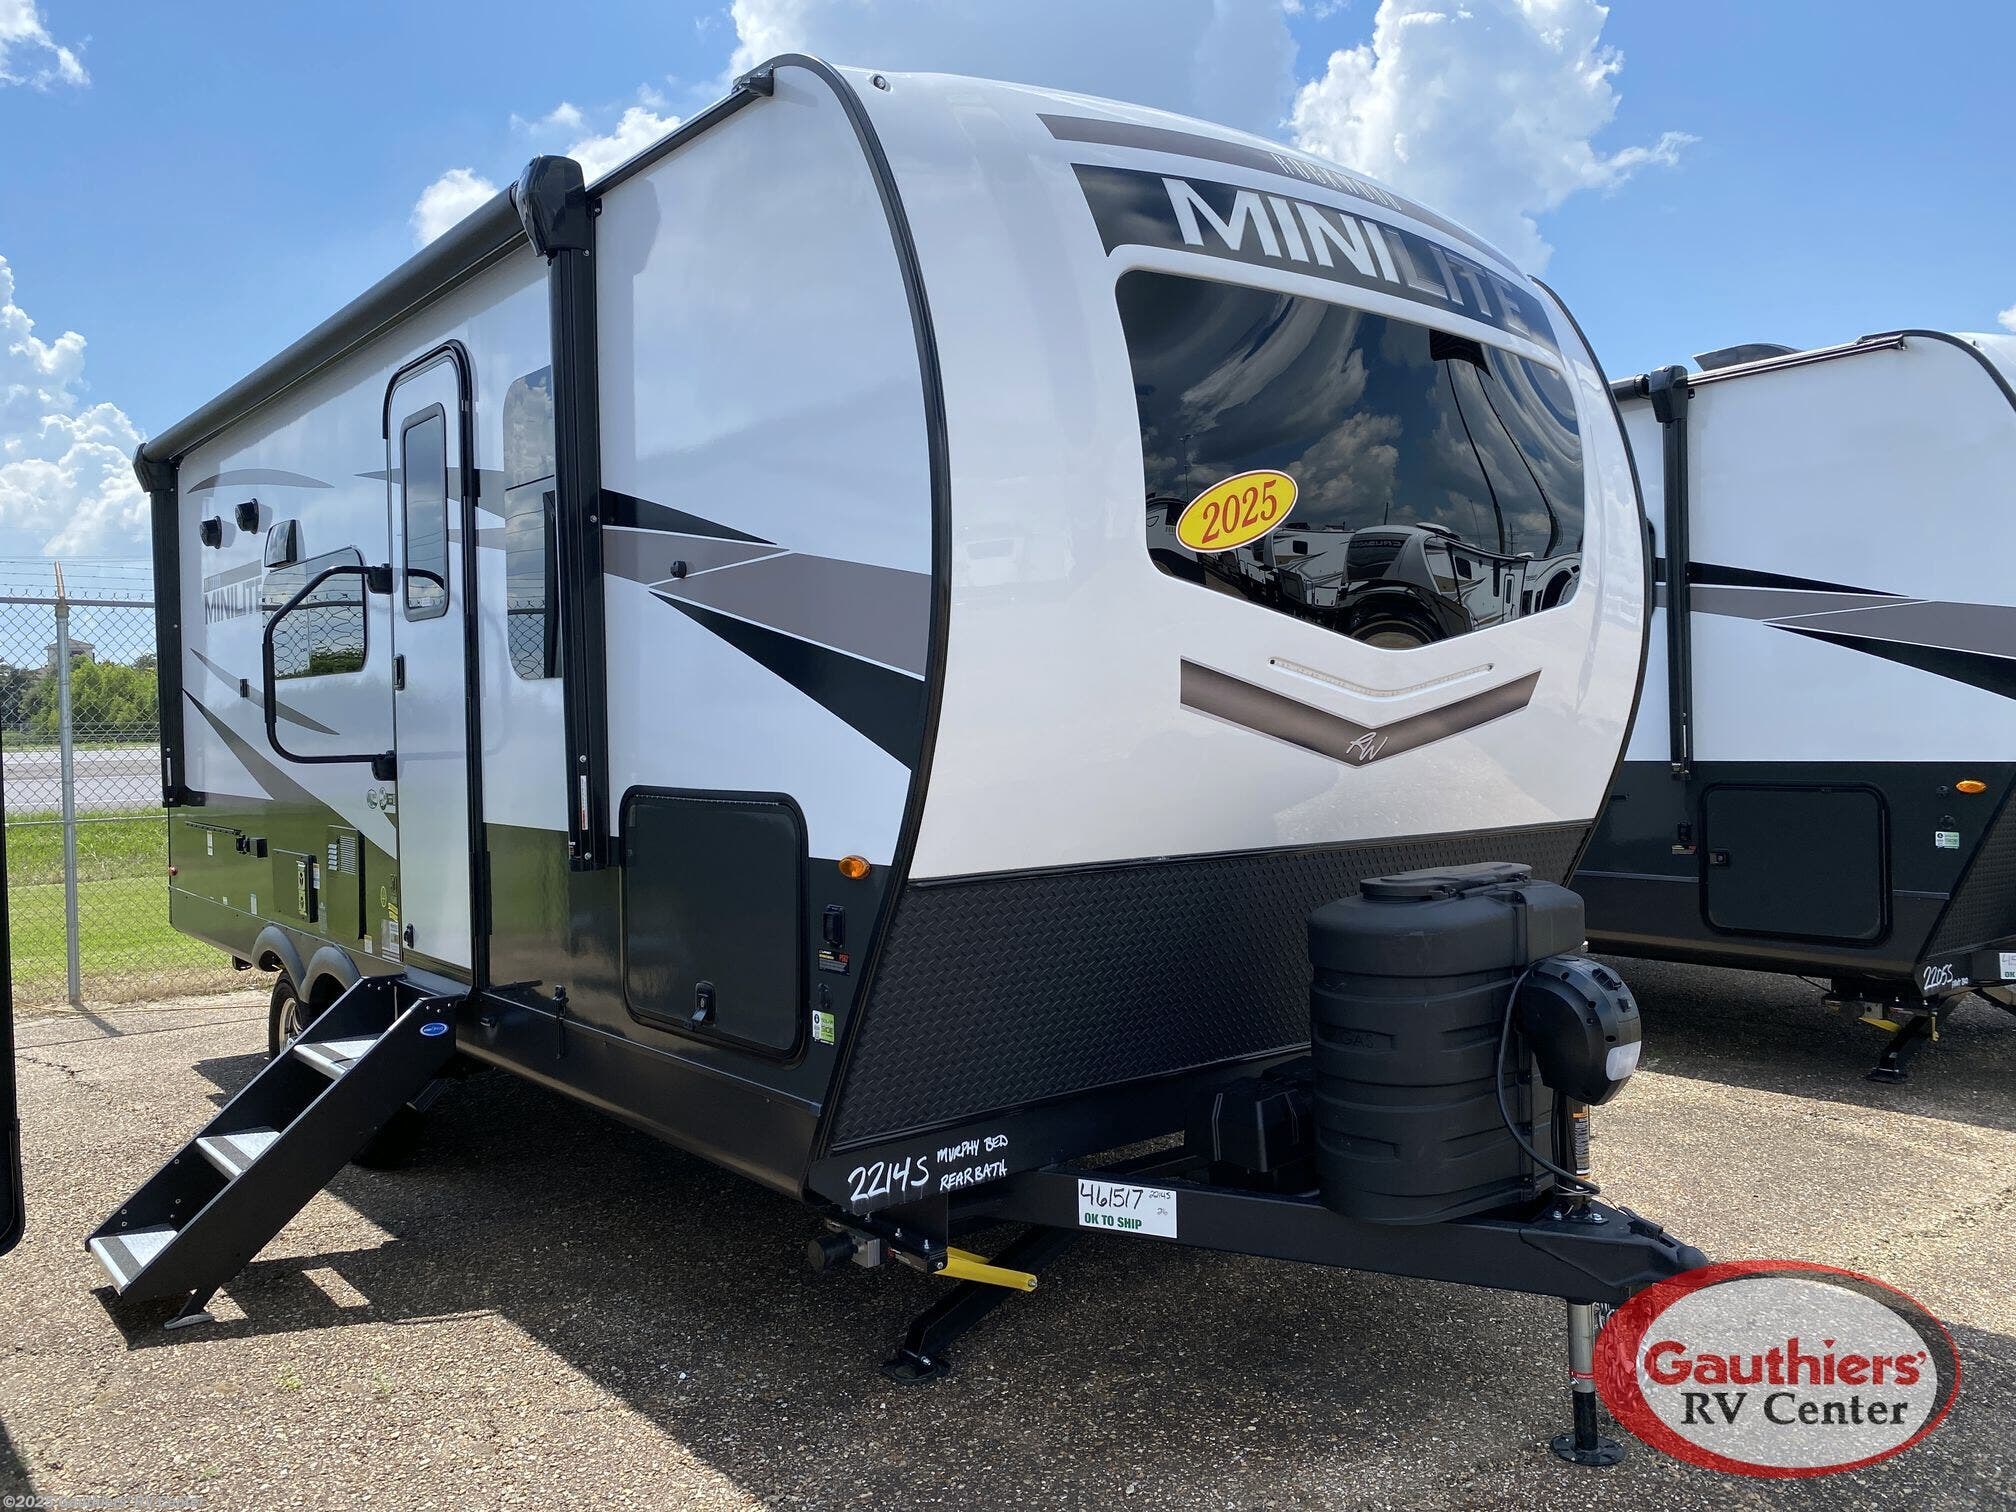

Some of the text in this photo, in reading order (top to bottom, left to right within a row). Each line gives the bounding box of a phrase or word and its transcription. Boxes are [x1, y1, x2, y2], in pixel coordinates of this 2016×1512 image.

[1202, 479, 1277, 544] 2025
[936, 1134, 1009, 1163] MURPHY BED
[939, 1159, 1008, 1192] REAR BATH
[1080, 1182, 1144, 1210] 461517
[1084, 1212, 1143, 1230] OK TO SHIP
